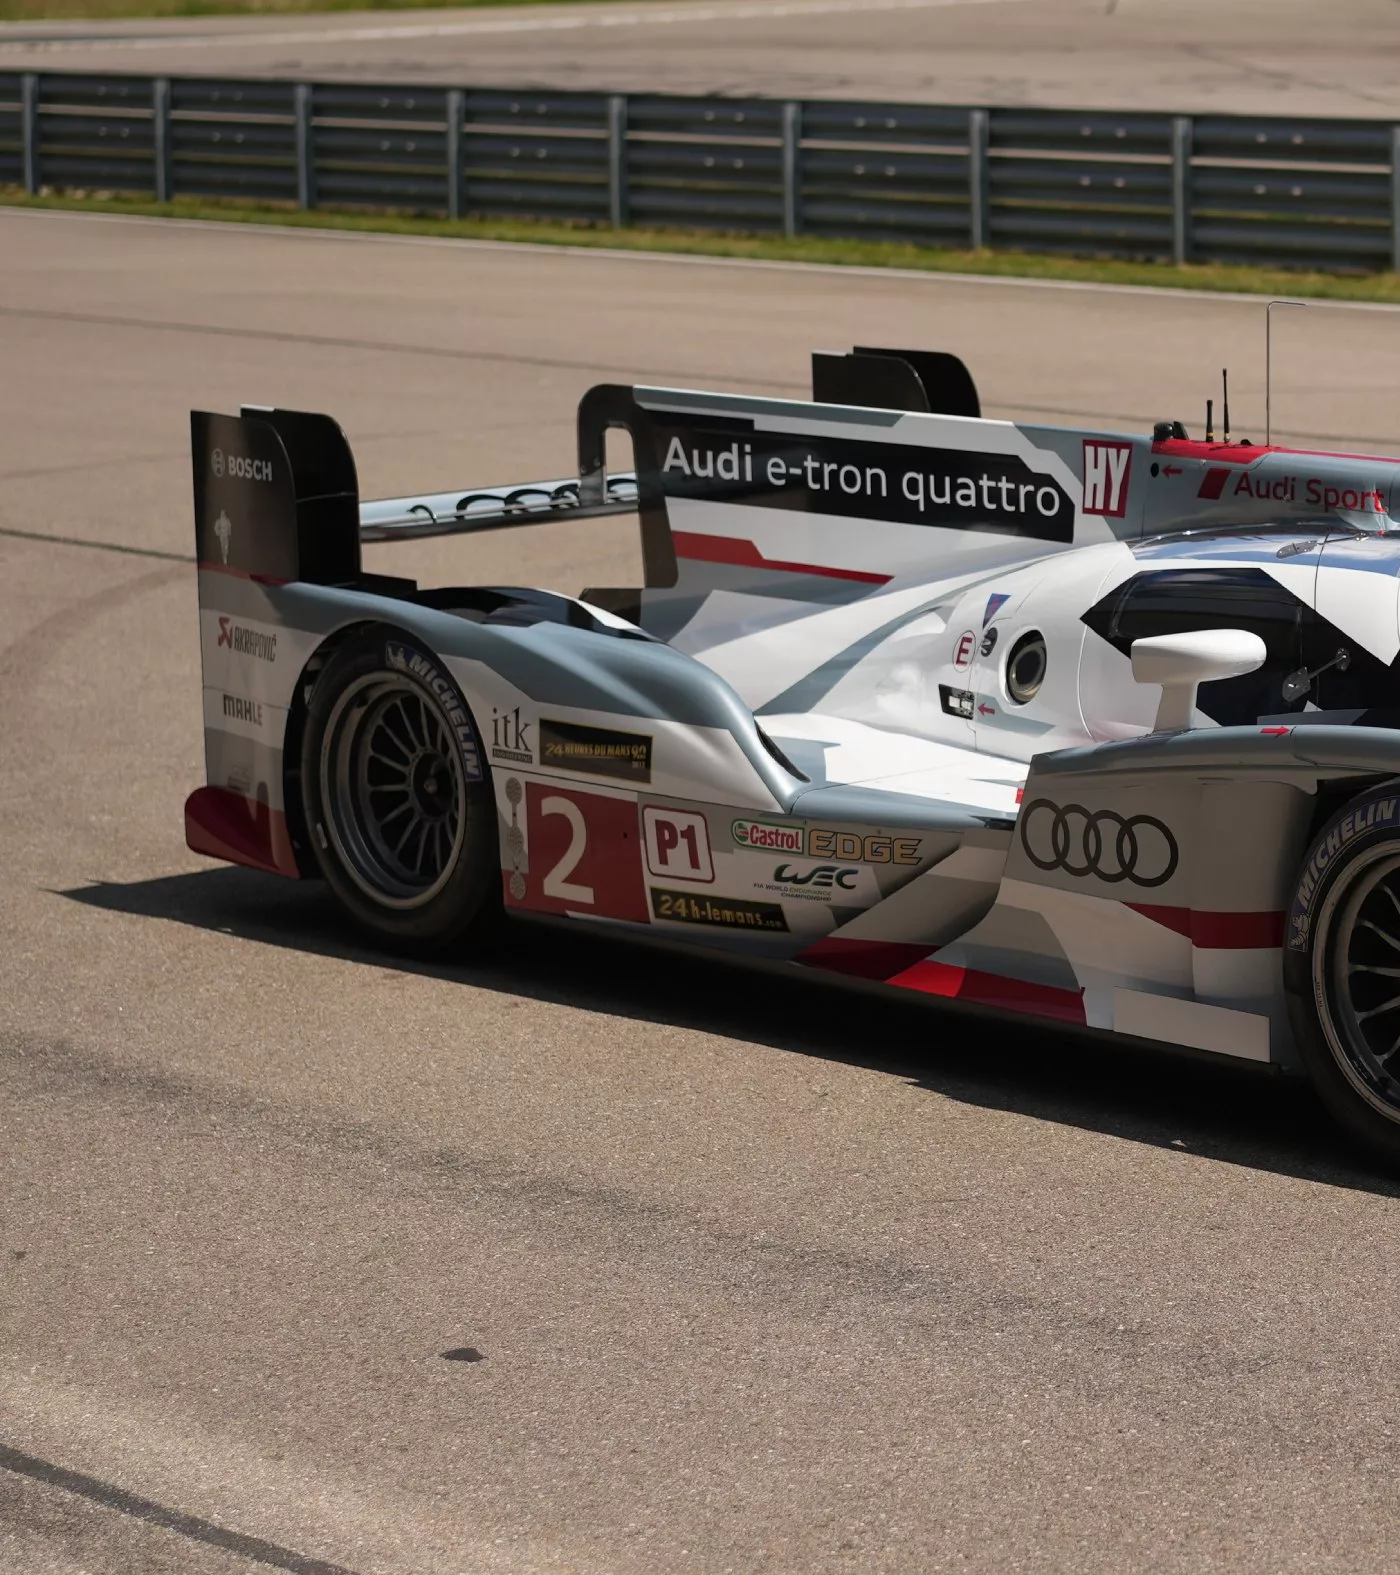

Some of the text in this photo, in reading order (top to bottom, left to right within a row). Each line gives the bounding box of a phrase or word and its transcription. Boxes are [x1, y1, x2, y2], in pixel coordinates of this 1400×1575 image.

[228, 455, 273, 482] BOSCH
[663, 436, 1060, 517] Audi e-tron quattro
[1083, 446, 1130, 512] HY
[1233, 471, 1385, 514] Audi Sport
[956, 636, 973, 665] E
[223, 694, 263, 726] MAHLE
[408, 654, 479, 776] MICHELIN
[492, 706, 532, 752] itk
[545, 742, 564, 758] 24
[594, 743, 607, 756] DU
[607, 744, 630, 757] MANS
[541, 796, 594, 905] 2
[655, 819, 701, 871] P1
[749, 824, 923, 866] Castrol EDGE
[1297, 799, 1397, 908] MICHELIN
[774, 863, 859, 890] WEC
